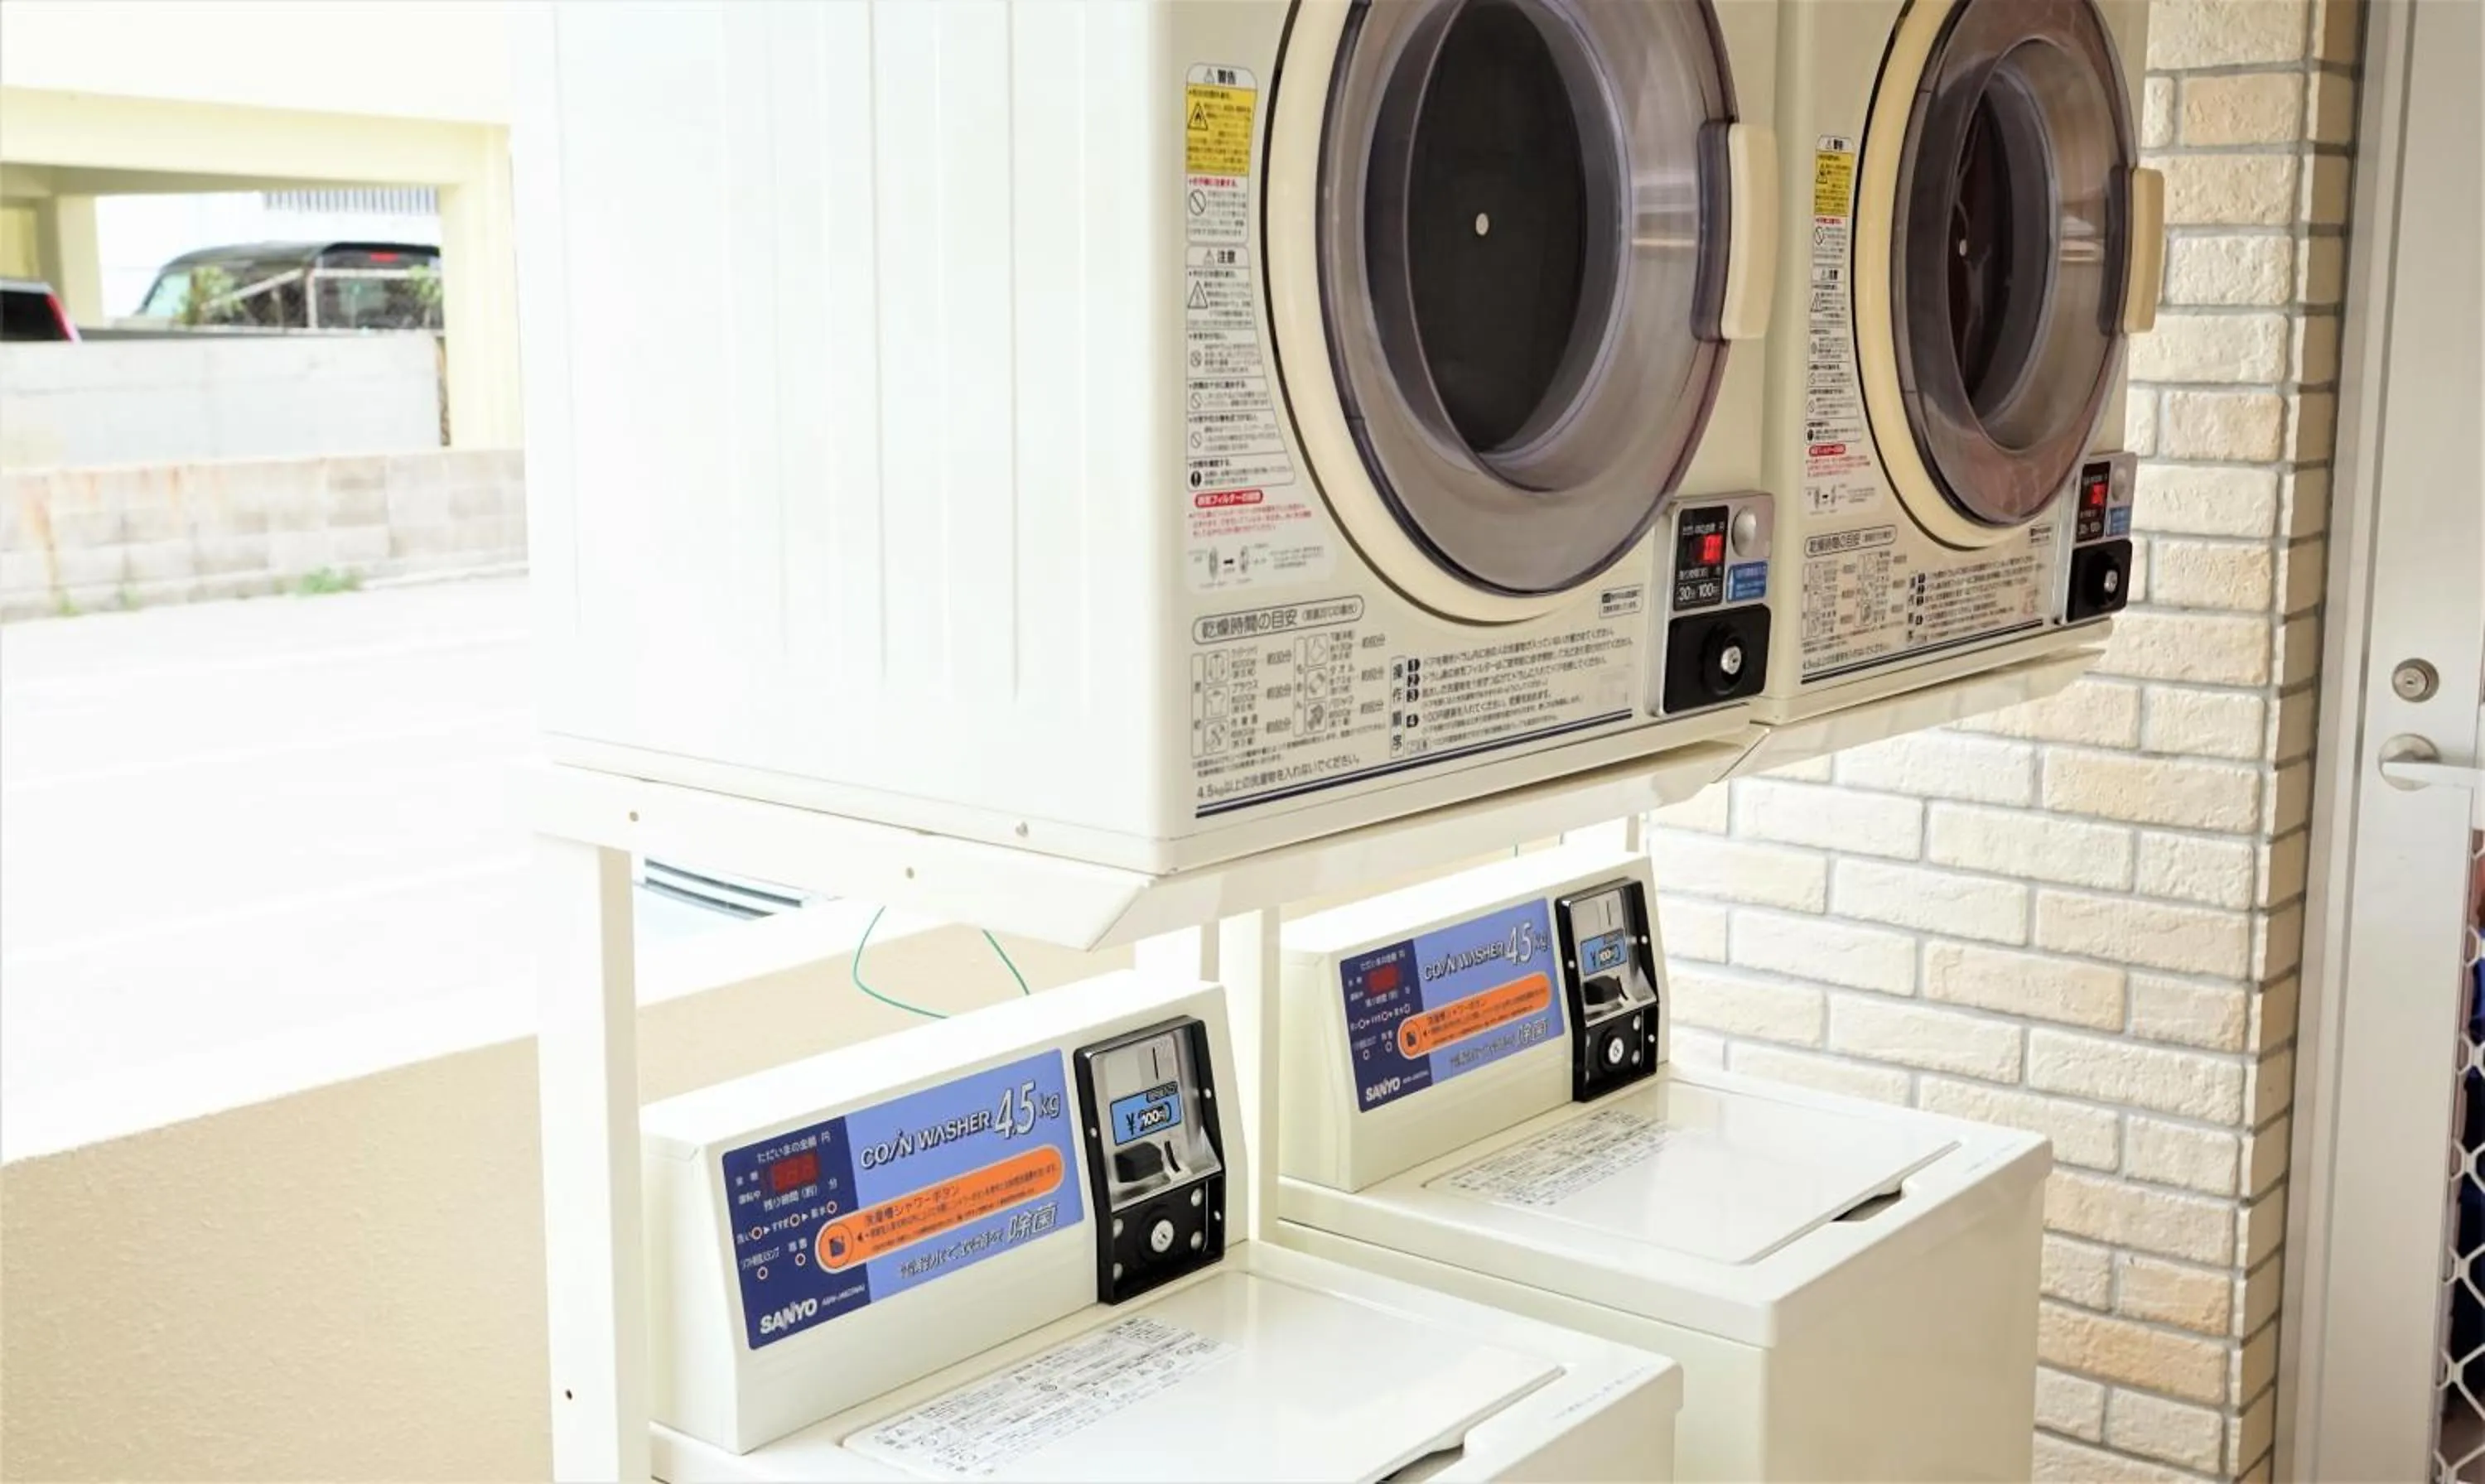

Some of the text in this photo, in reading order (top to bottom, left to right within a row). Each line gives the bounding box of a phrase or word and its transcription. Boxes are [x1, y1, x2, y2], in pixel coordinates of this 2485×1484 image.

[1365, 1077, 1400, 1101] SANYO
[917, 1110, 993, 1150] WASHER
[1039, 1092, 1061, 1119] kg
[760, 1298, 818, 1334] SANYO
